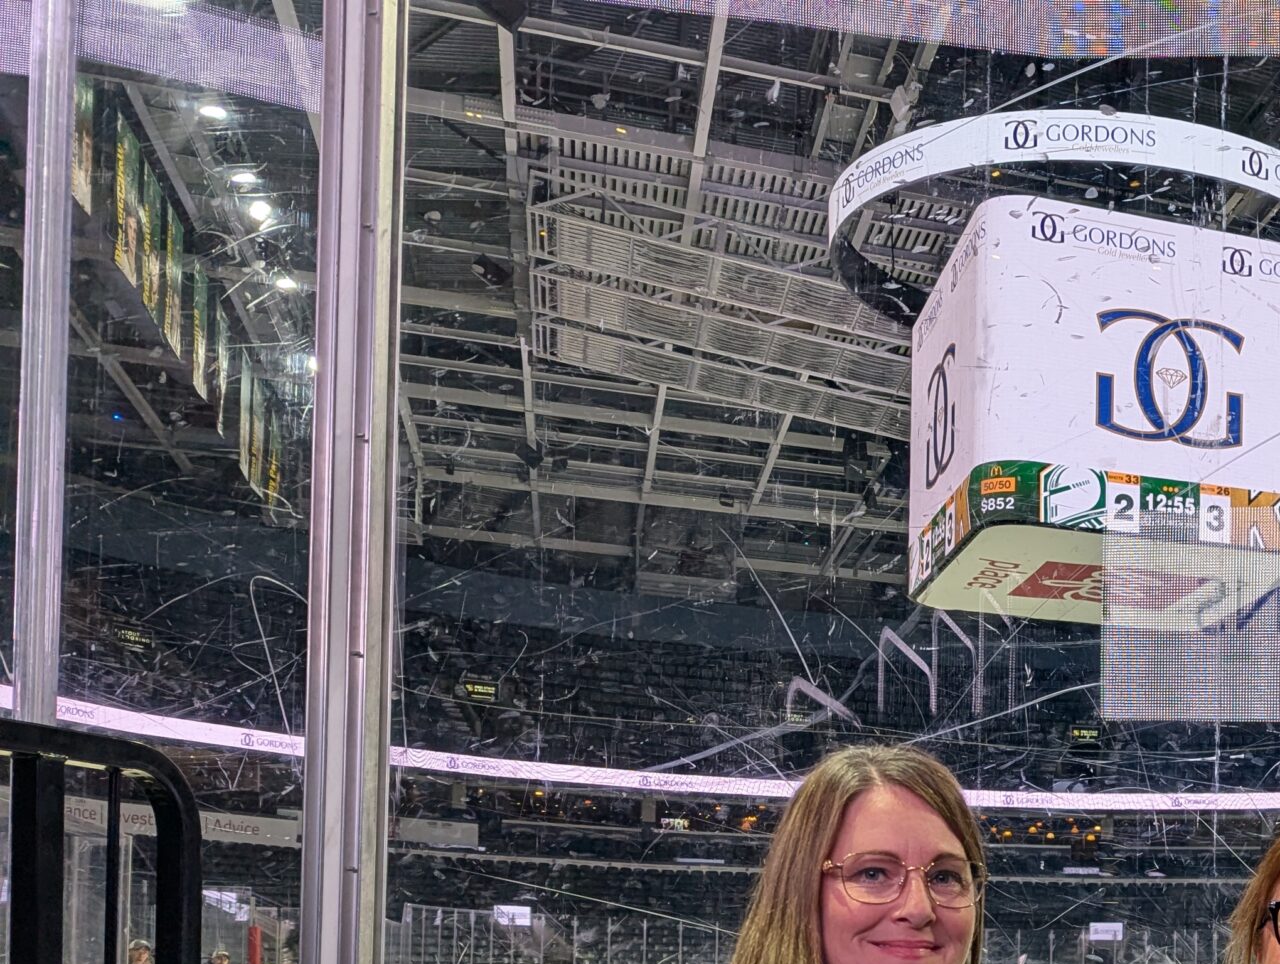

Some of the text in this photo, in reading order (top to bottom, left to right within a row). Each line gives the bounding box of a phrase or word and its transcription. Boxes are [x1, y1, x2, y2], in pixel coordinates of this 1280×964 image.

[1046, 123, 1156, 148] GORDONS
[857, 144, 924, 188] GORDONS
[1073, 224, 1176, 258] GORDONS
[983, 480, 1012, 491] 50/50
[1125, 474, 1140, 485] 33
[1216, 486, 1231, 496] 26
[981, 497, 1015, 513] $852
[1114, 493, 1134, 521] 2
[1145, 493, 1196, 516] 12:55
[1206, 505, 1225, 532] 3
[256, 737, 299, 750] GORDONS
[212, 818, 261, 836] Advice
